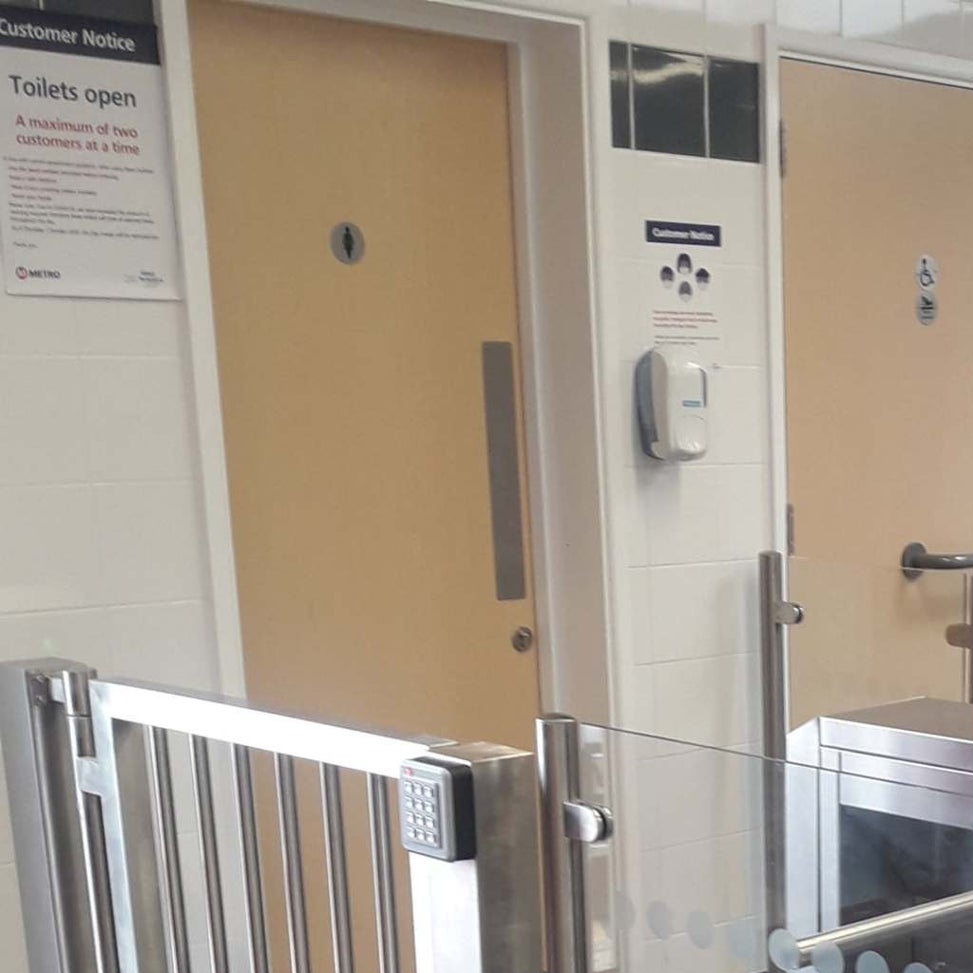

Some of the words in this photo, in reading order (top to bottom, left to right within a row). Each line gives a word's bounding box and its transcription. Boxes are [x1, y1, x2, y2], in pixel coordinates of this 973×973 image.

[0, 18, 77, 44] Customer
[82, 28, 136, 51] Notice
[8, 74, 78, 101] Toilets
[84, 87, 137, 109] open
[15, 114, 26, 127] A
[29, 116, 93, 133] maximum
[96, 122, 110, 135] of
[112, 125, 139, 138] two
[16, 132, 82, 149] customers
[85, 138, 98, 150] at
[101, 142, 110, 151] a
[112, 140, 141, 155] time
[29, 269, 61, 279] METRO
